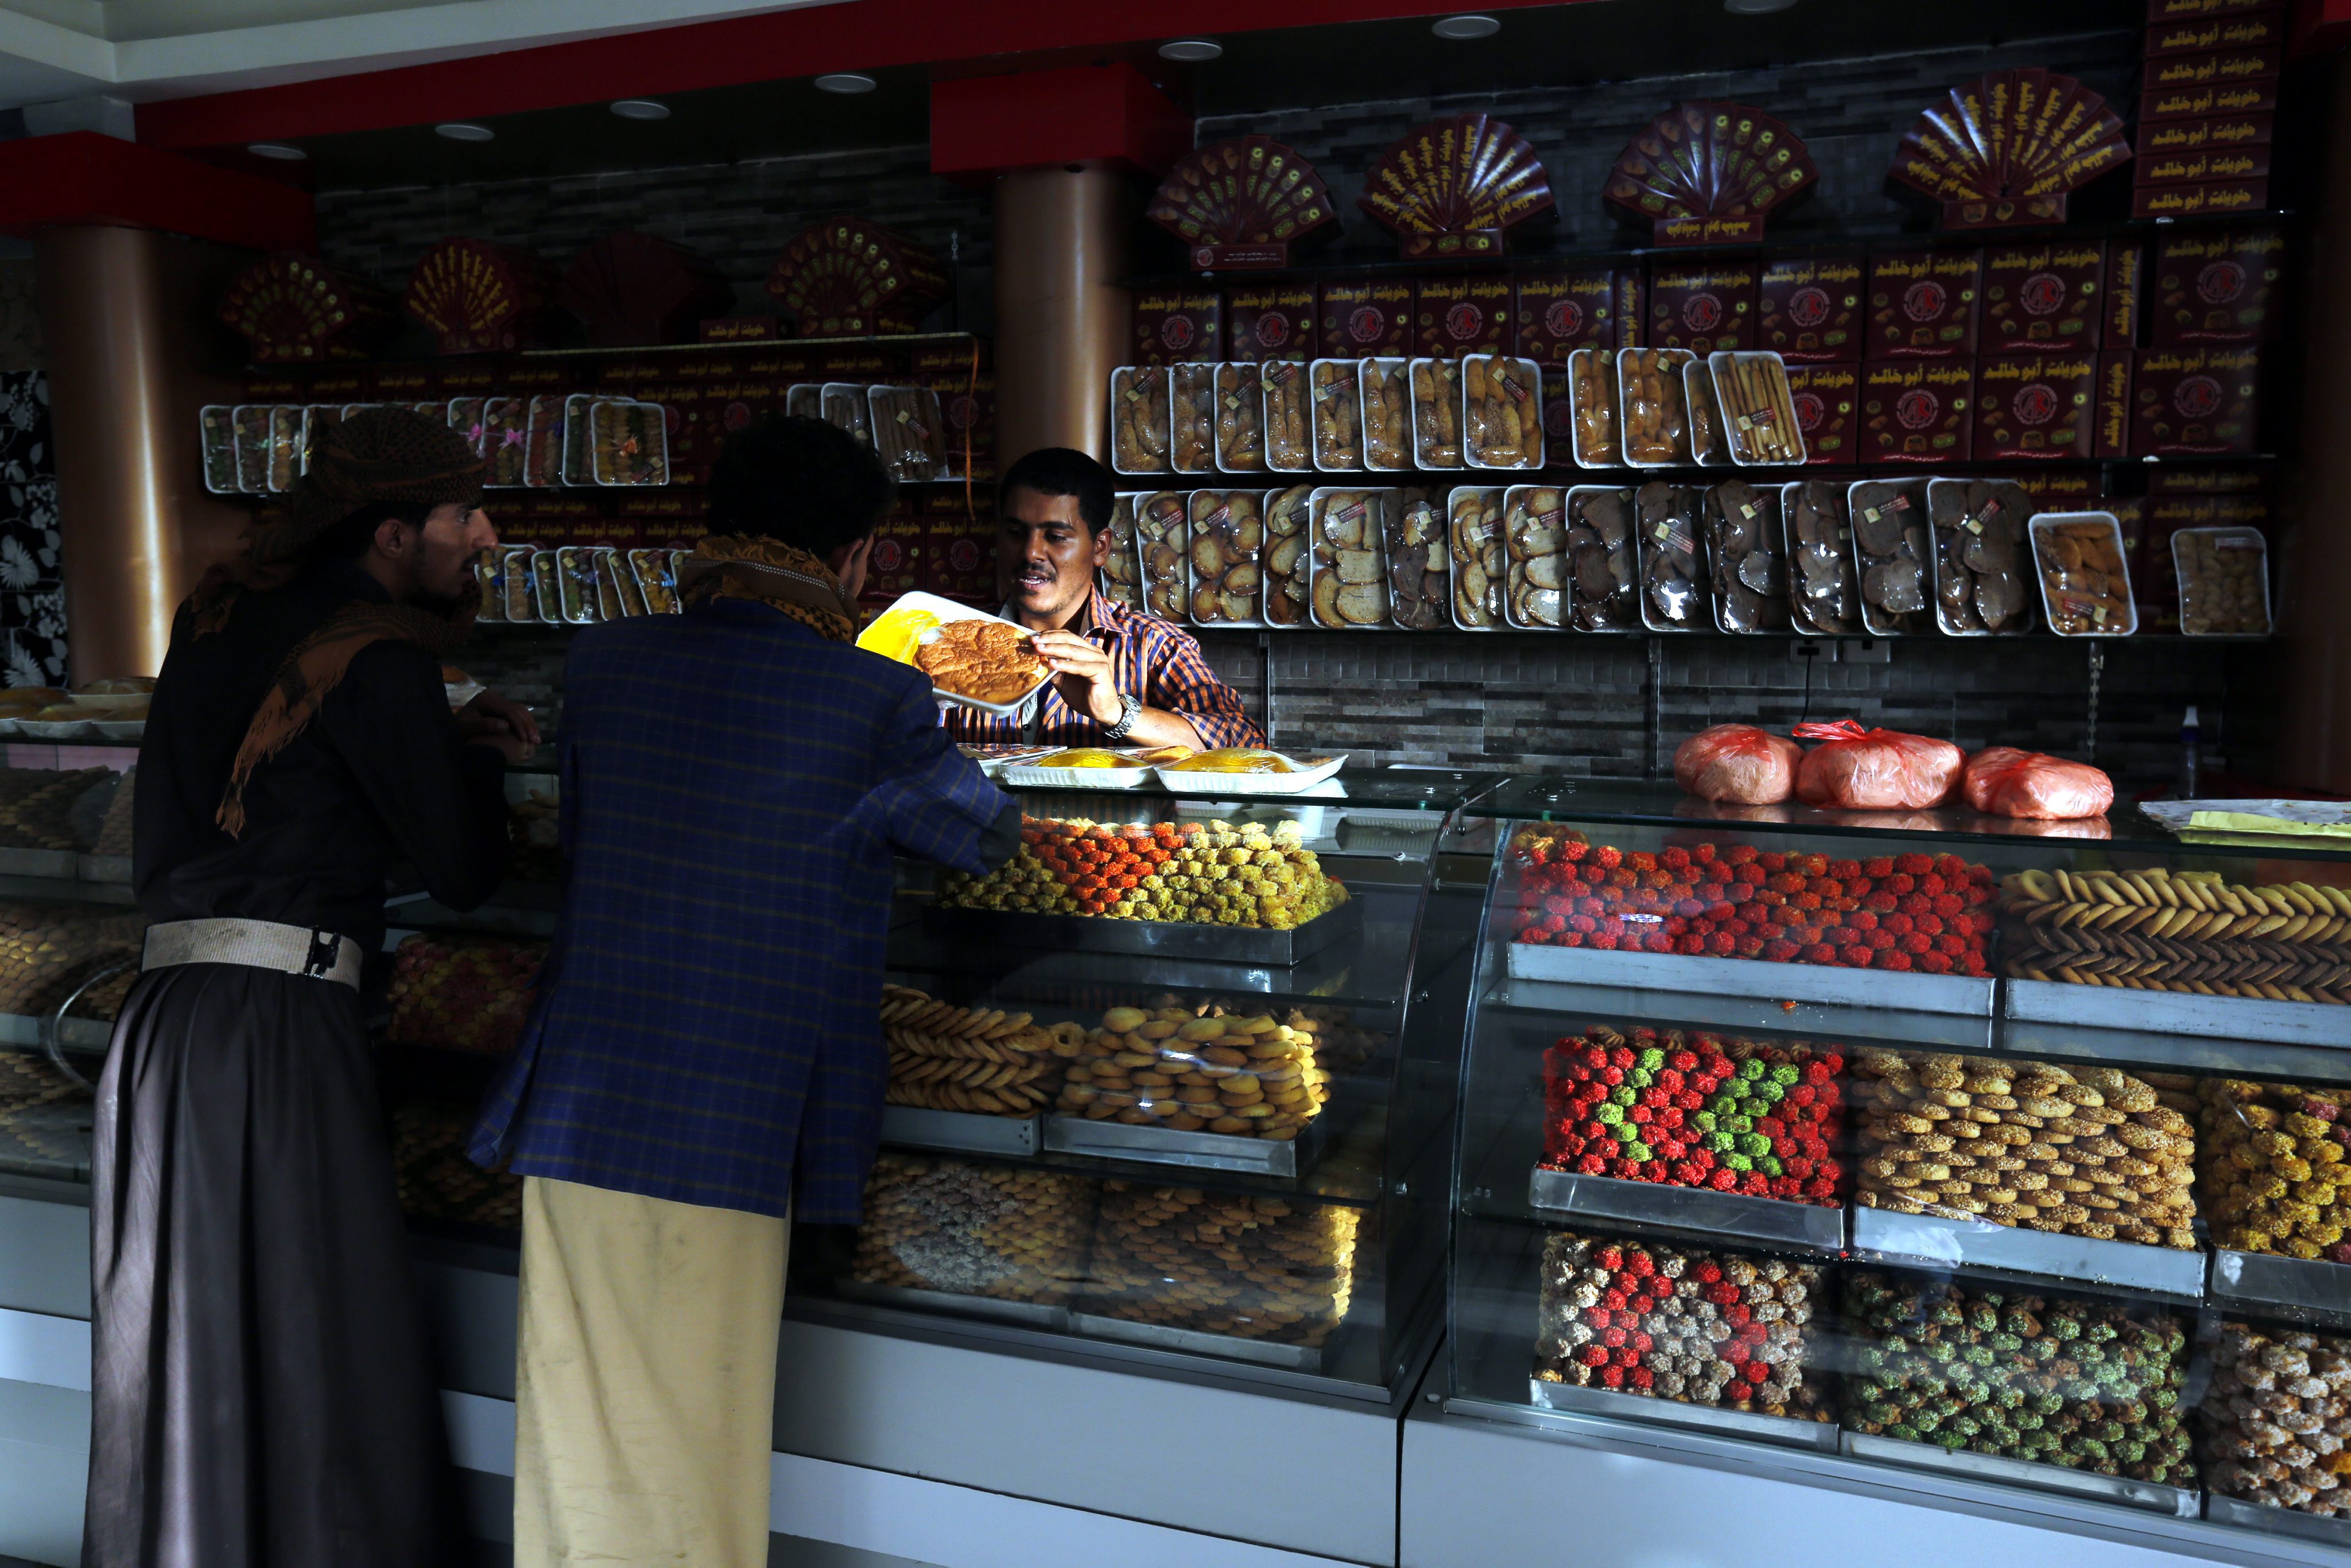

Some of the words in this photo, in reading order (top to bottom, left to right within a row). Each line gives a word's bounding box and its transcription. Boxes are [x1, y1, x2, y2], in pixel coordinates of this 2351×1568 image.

[2162, 31, 2197, 48] خالد
[2199, 22, 2218, 47] أبو
[2224, 22, 2267, 41] حلويات
[2159, 64, 2195, 81] خالد
[2197, 57, 2216, 80] أبو
[2221, 56, 2264, 75] حلويات
[2156, 96, 2191, 112] خالد
[2193, 89, 2213, 112] أبو
[2217, 88, 2261, 108] حلويات
[2152, 129, 2187, 145] خالد
[2189, 122, 2208, 145] أبو
[2213, 122, 2256, 141] حلويات
[2150, 162, 2185, 177] خالد
[2187, 156, 2206, 178] أبو
[2210, 156, 2254, 174] حلويات
[2148, 195, 2183, 209] خالد
[2184, 188, 2204, 211] أبو
[2208, 188, 2251, 207] حلويات
